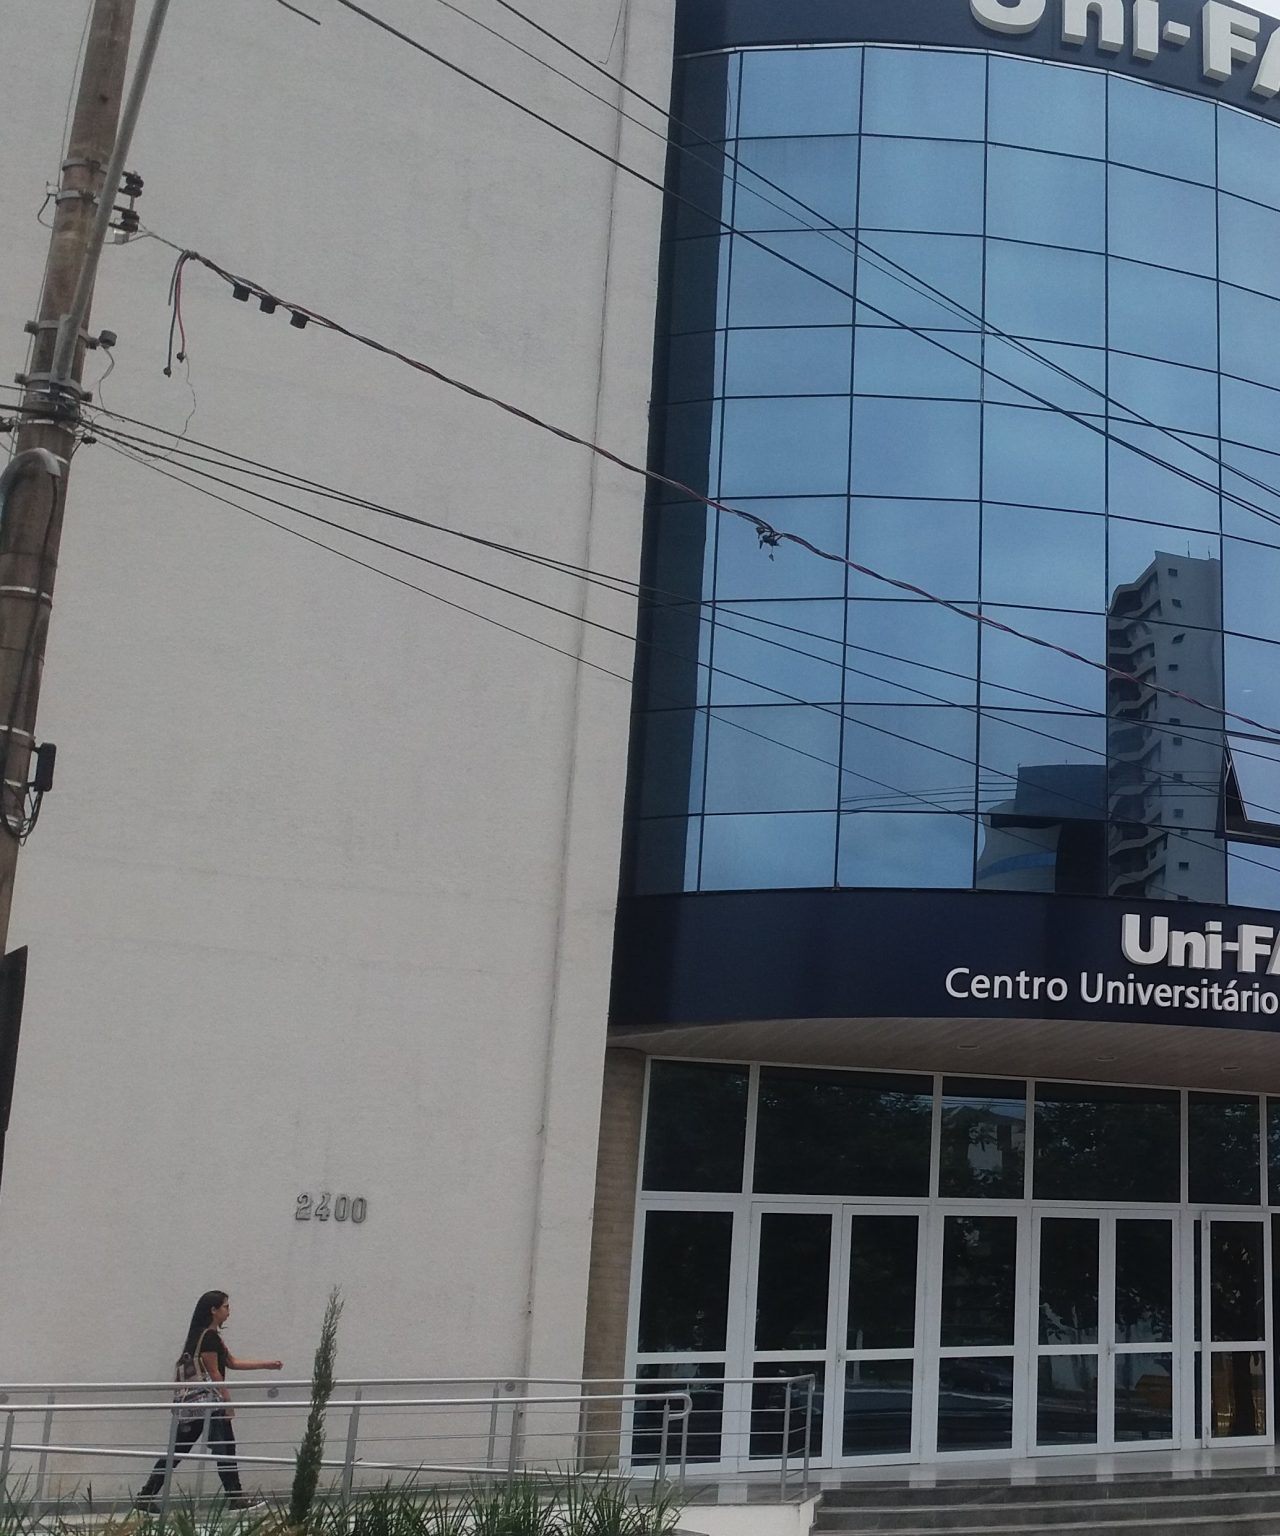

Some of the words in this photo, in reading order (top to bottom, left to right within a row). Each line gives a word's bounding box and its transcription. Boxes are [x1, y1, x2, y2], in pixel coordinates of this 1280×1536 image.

[944, 966, 1068, 1002] Centro
[1079, 971, 1279, 1015] Universitário
[295, 1191, 368, 1224] 2400
